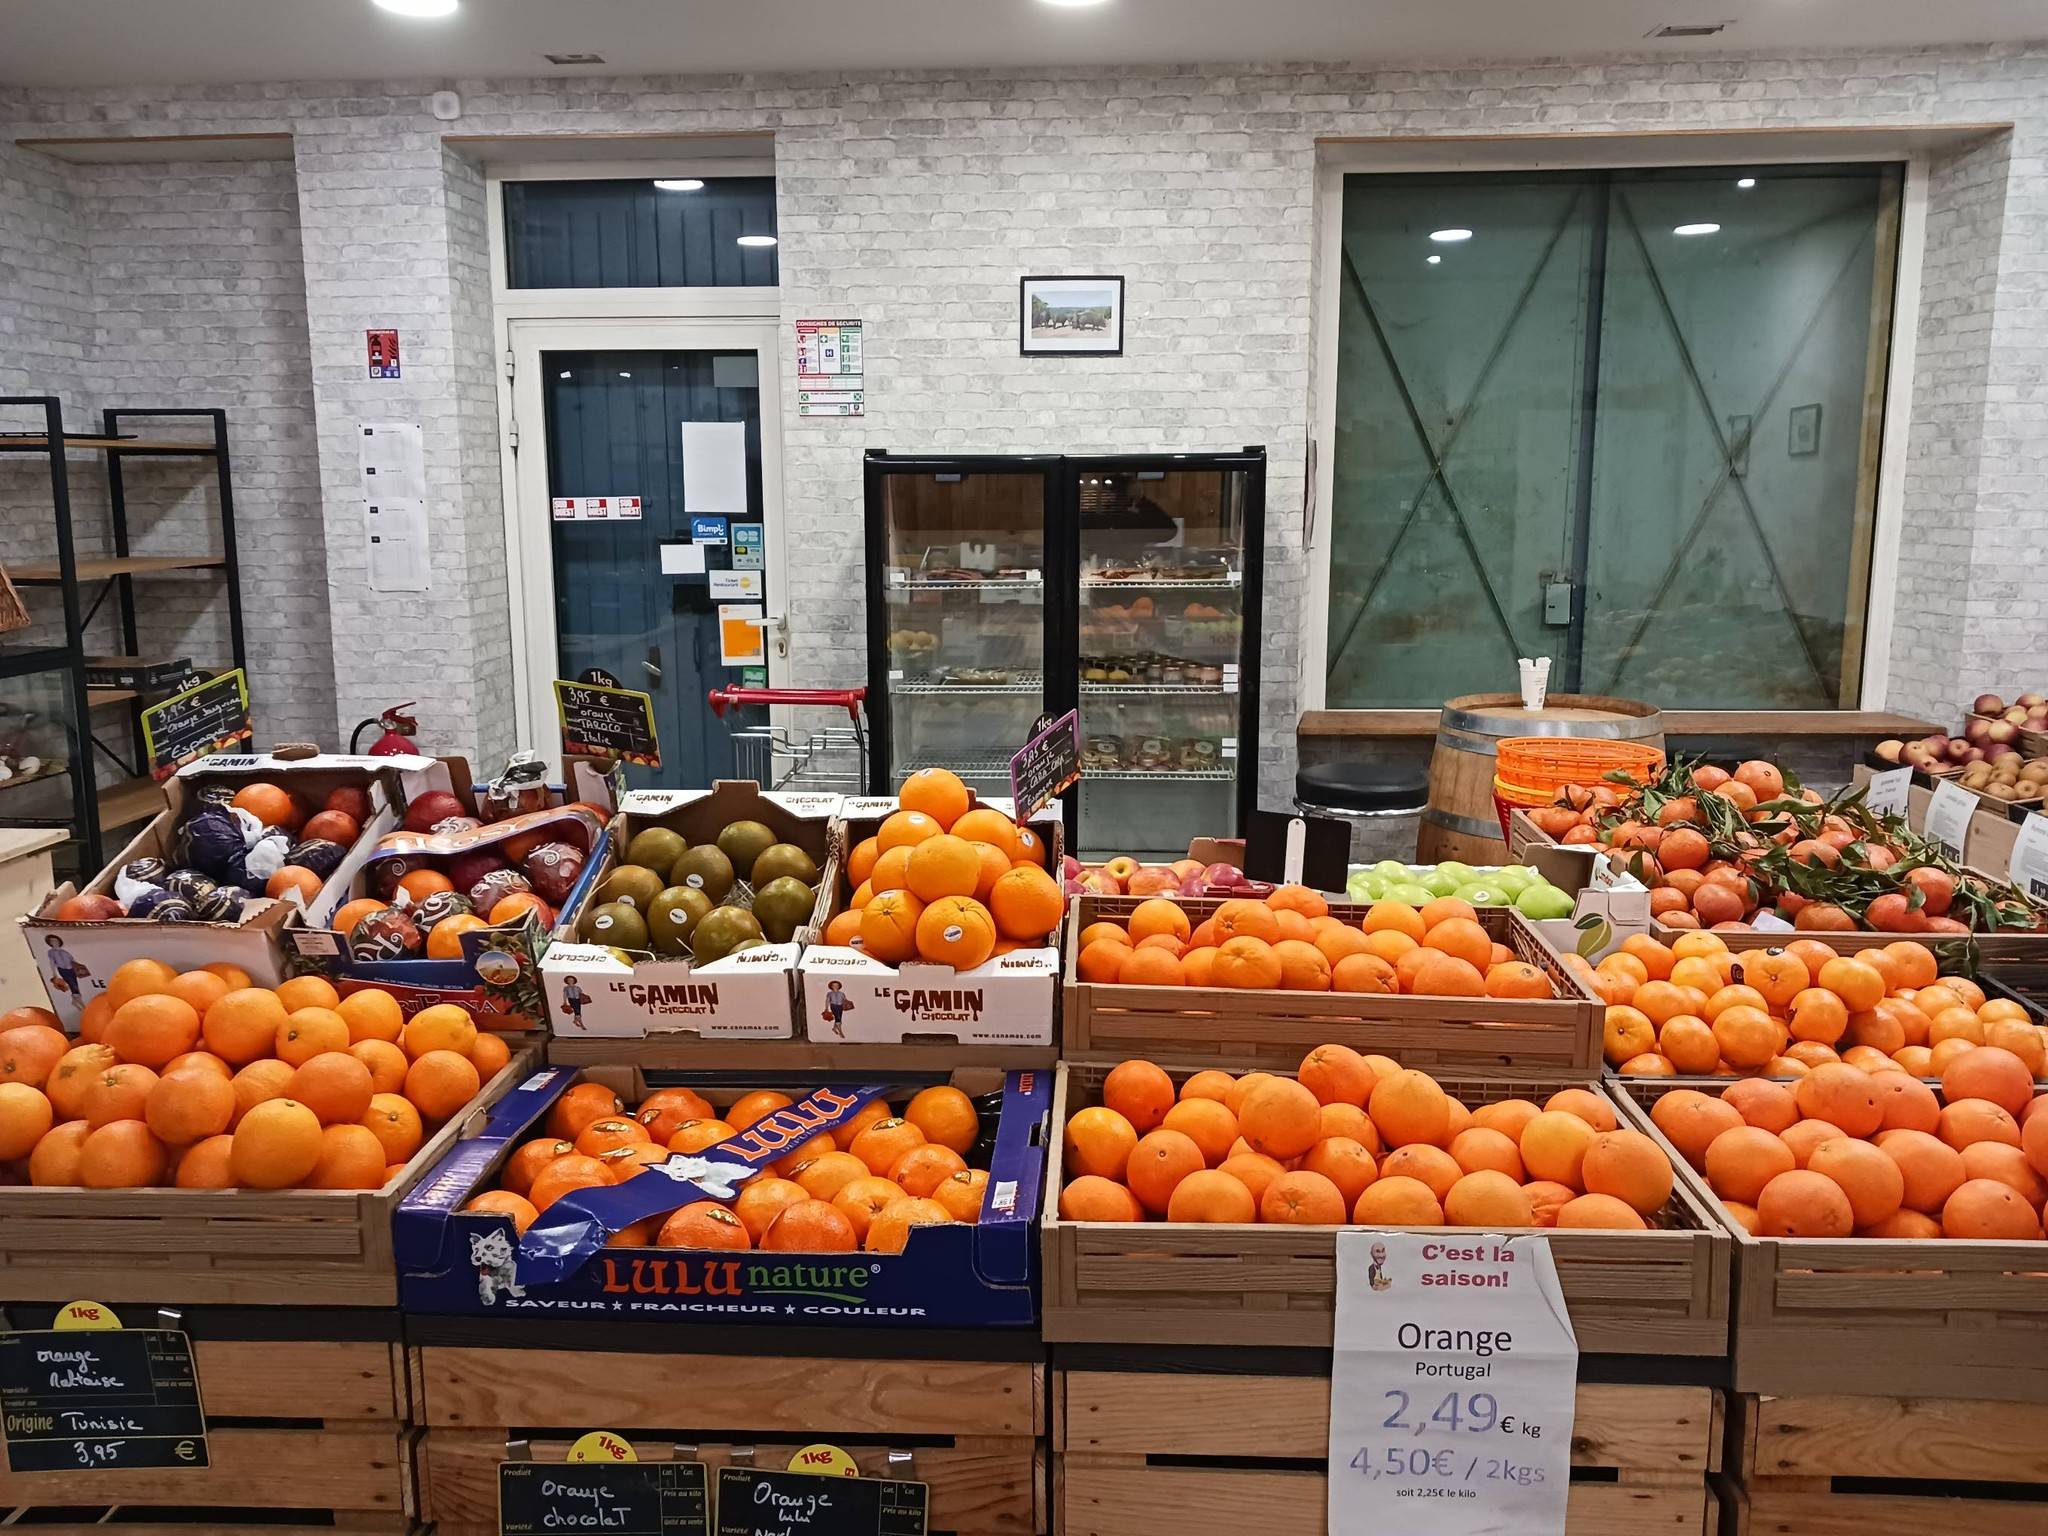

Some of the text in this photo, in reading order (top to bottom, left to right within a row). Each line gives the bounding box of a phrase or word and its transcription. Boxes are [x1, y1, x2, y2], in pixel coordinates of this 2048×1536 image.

[176, 675, 200, 693] 1kg
[591, 671, 613, 688] 1kg
[190, 696, 201, 707] €
[600, 695, 610, 706] €
[1037, 716, 1052, 732] 1kg
[91, 979, 107, 989] LE
[609, 982, 720, 1011] LE GAMIN
[874, 987, 984, 1016] LE GAMIN
[659, 1006, 707, 1015] CHOCOLAT
[921, 1012, 970, 1022] CHOCOLAT
[717, 1087, 858, 1162] LULU
[1493, 1246, 1516, 1262] la
[602, 1259, 743, 1296] LULU
[1421, 1270, 1509, 1288] saison!
[69, 1307, 100, 1320] 1kg
[505, 1300, 927, 1316] SAVEUR FRAICHEUR COULEUR
[1397, 1322, 1513, 1357] Orange
[1415, 1362, 1492, 1381] Portugal
[7, 1411, 144, 1434] Origine Tunisie
[1383, 1390, 1541, 1438] 2,49 € kg
[73, 1440, 197, 1467] 3,95 €
[599, 1436, 628, 1460] 1kg
[801, 1450, 833, 1465] 1kg
[1350, 1447, 1455, 1480] 4,50€
[1486, 1458, 1545, 1486] 2kgs
[753, 1482, 833, 1515] Orange
[1396, 1488, 1476, 1499] soit 2,25€ le kilo
